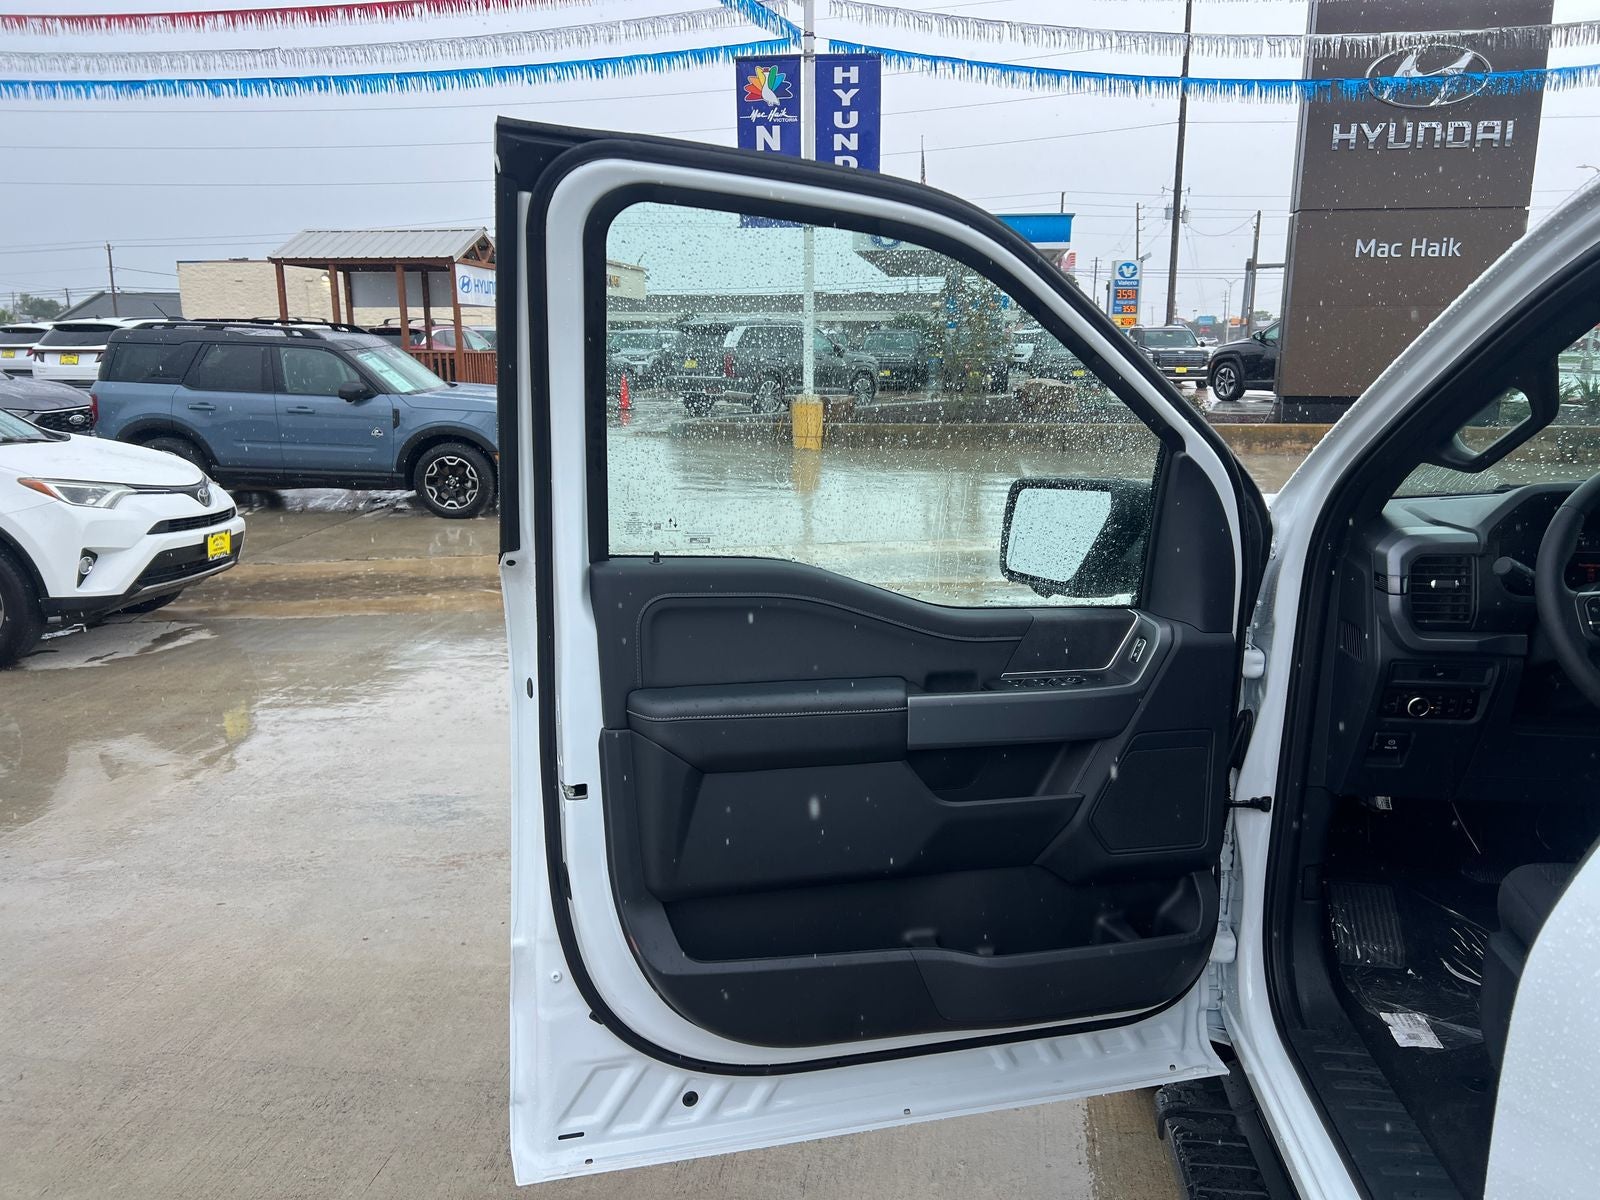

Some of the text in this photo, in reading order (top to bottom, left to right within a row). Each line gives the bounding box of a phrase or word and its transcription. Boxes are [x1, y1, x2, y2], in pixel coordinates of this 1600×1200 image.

[750, 109, 767, 122] Mac
[755, 125, 781, 151] N
[1331, 120, 1515, 150] HYUNDAI
[1354, 237, 1462, 258] Mac Haik
[473, 278, 496, 295] HYUN
